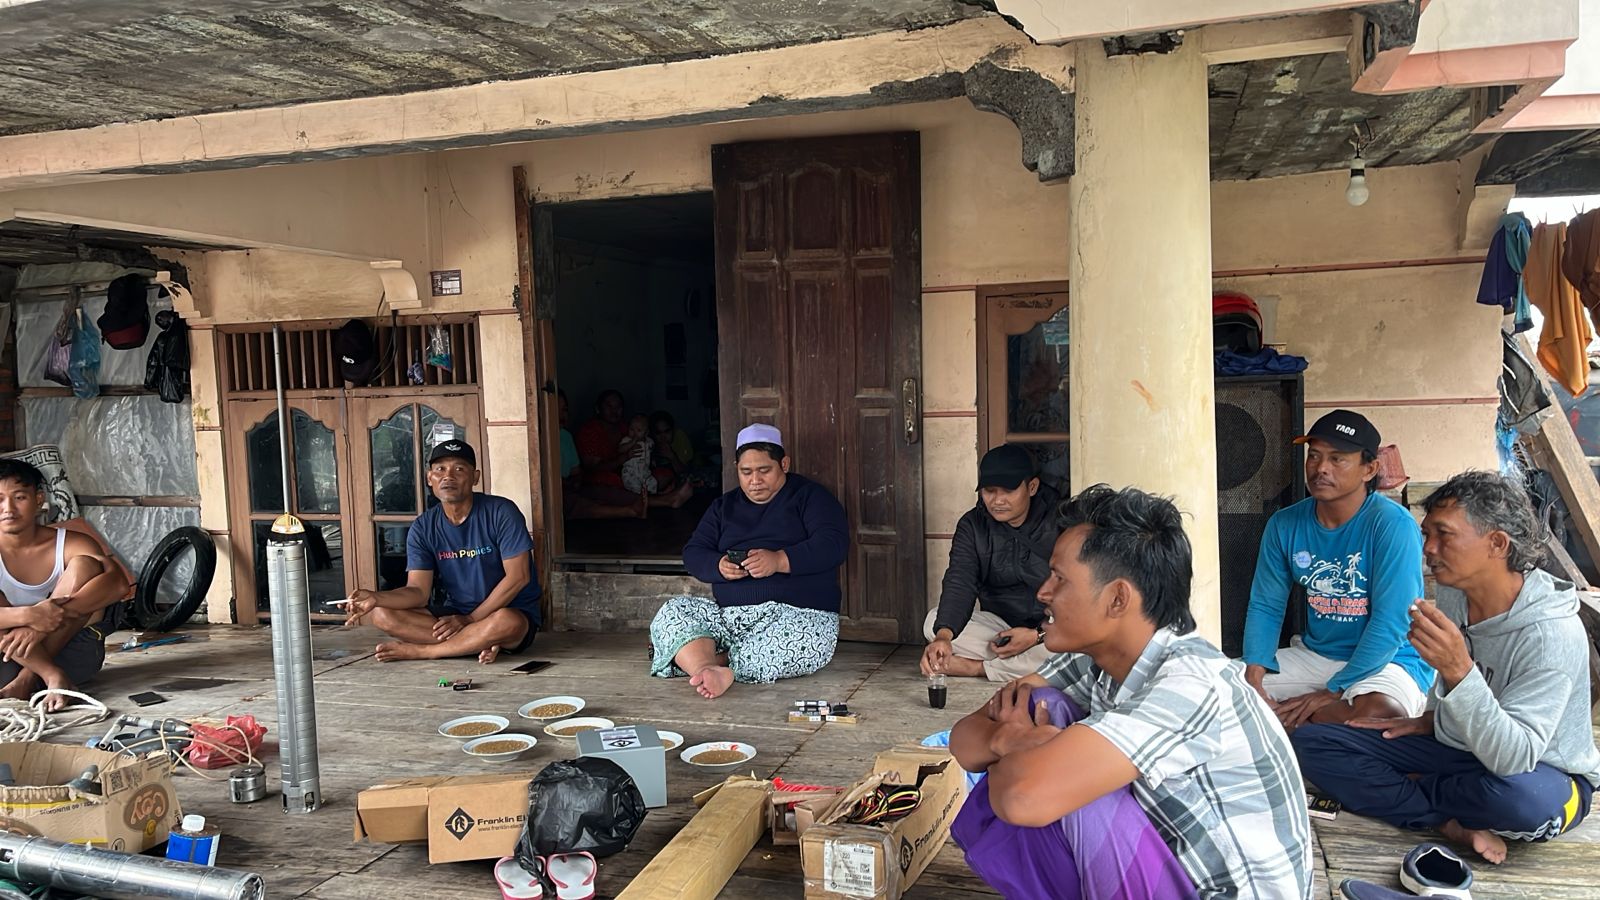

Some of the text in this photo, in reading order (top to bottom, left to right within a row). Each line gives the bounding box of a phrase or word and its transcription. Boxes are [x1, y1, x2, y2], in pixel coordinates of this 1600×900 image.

[1335, 424, 1356, 436] TACO
[477, 816, 515, 825] Franklin
[914, 817, 943, 852] Franklin
